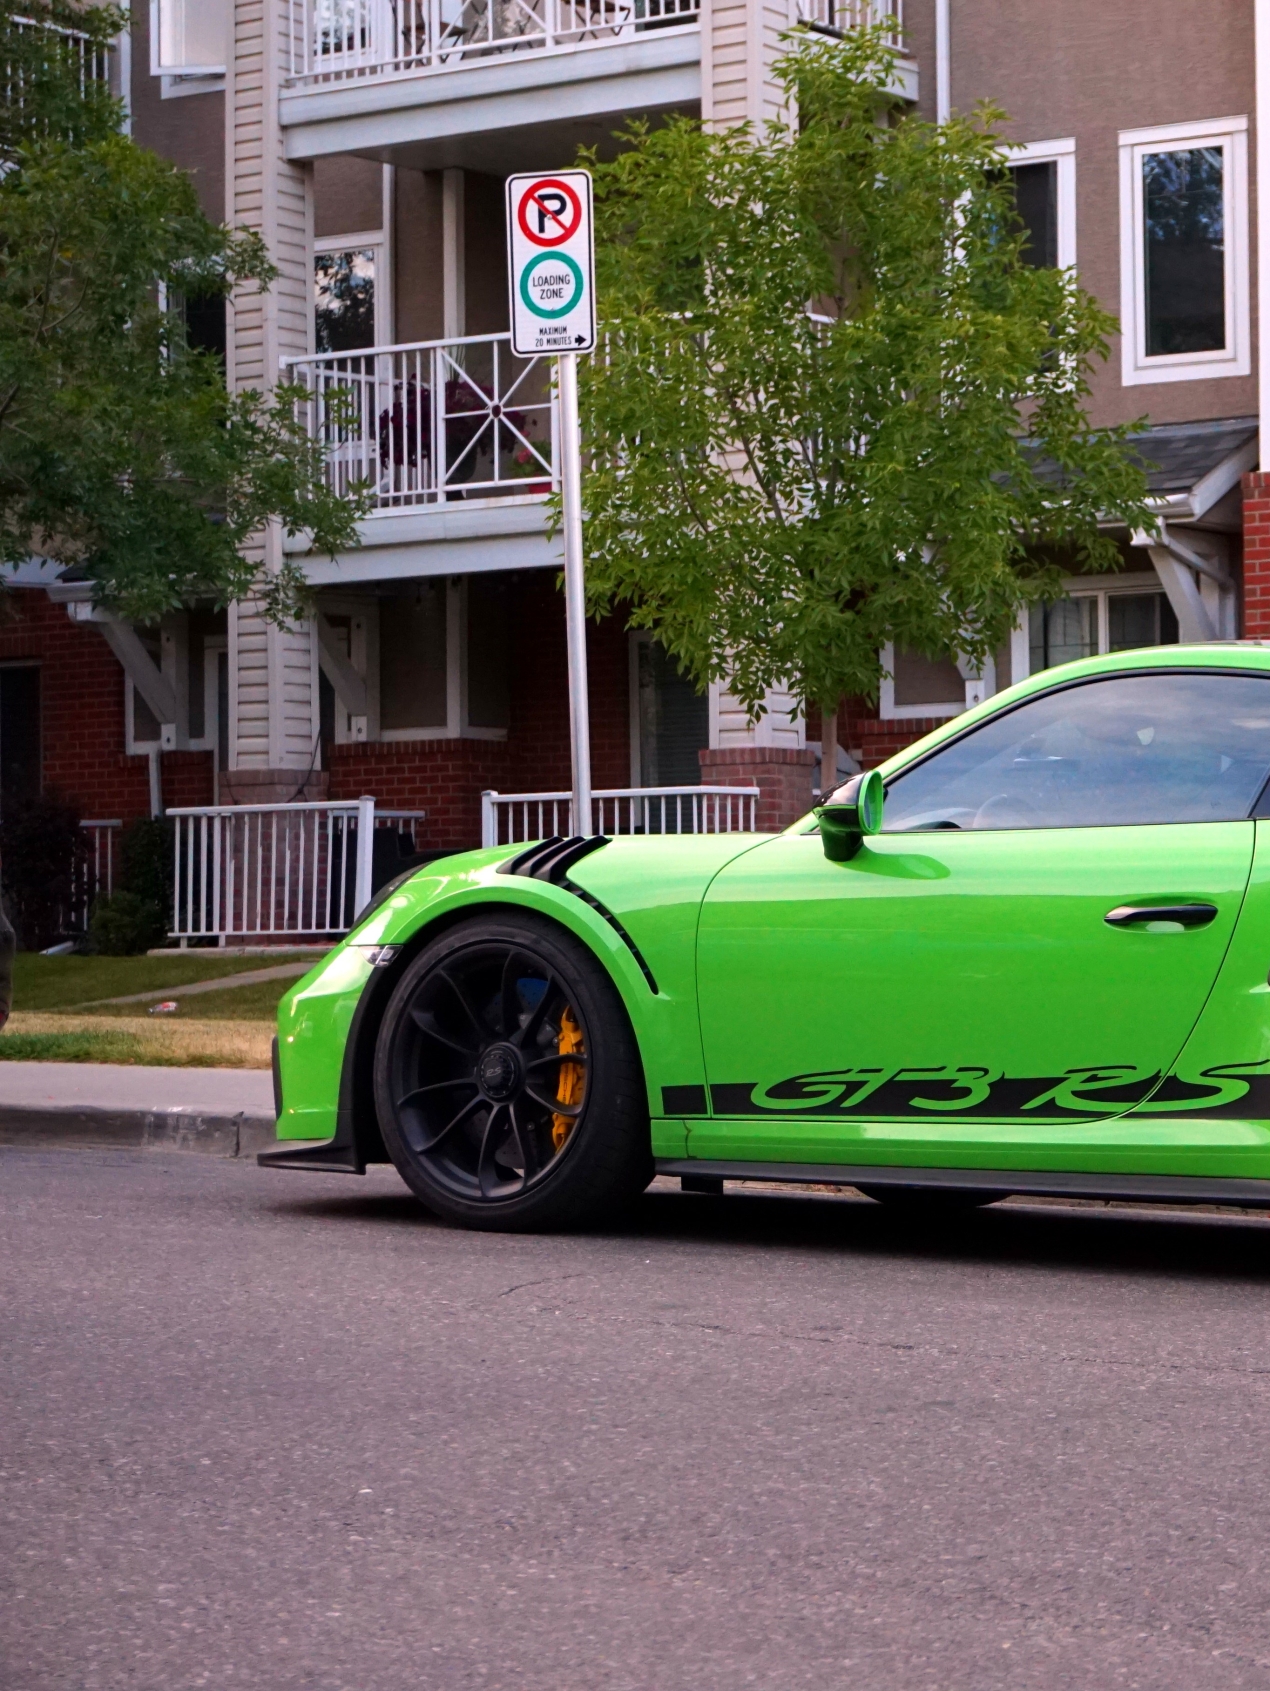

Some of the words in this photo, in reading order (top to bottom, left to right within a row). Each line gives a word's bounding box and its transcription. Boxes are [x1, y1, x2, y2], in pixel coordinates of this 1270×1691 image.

[537, 193, 567, 233] P
[532, 274, 571, 288] LOADING
[540, 287, 564, 300] ZONE
[539, 326, 568, 336] MAXIMUM
[535, 338, 544, 347] 20
[546, 336, 572, 347] MINUTES
[750, 1065, 993, 1111] GT3
